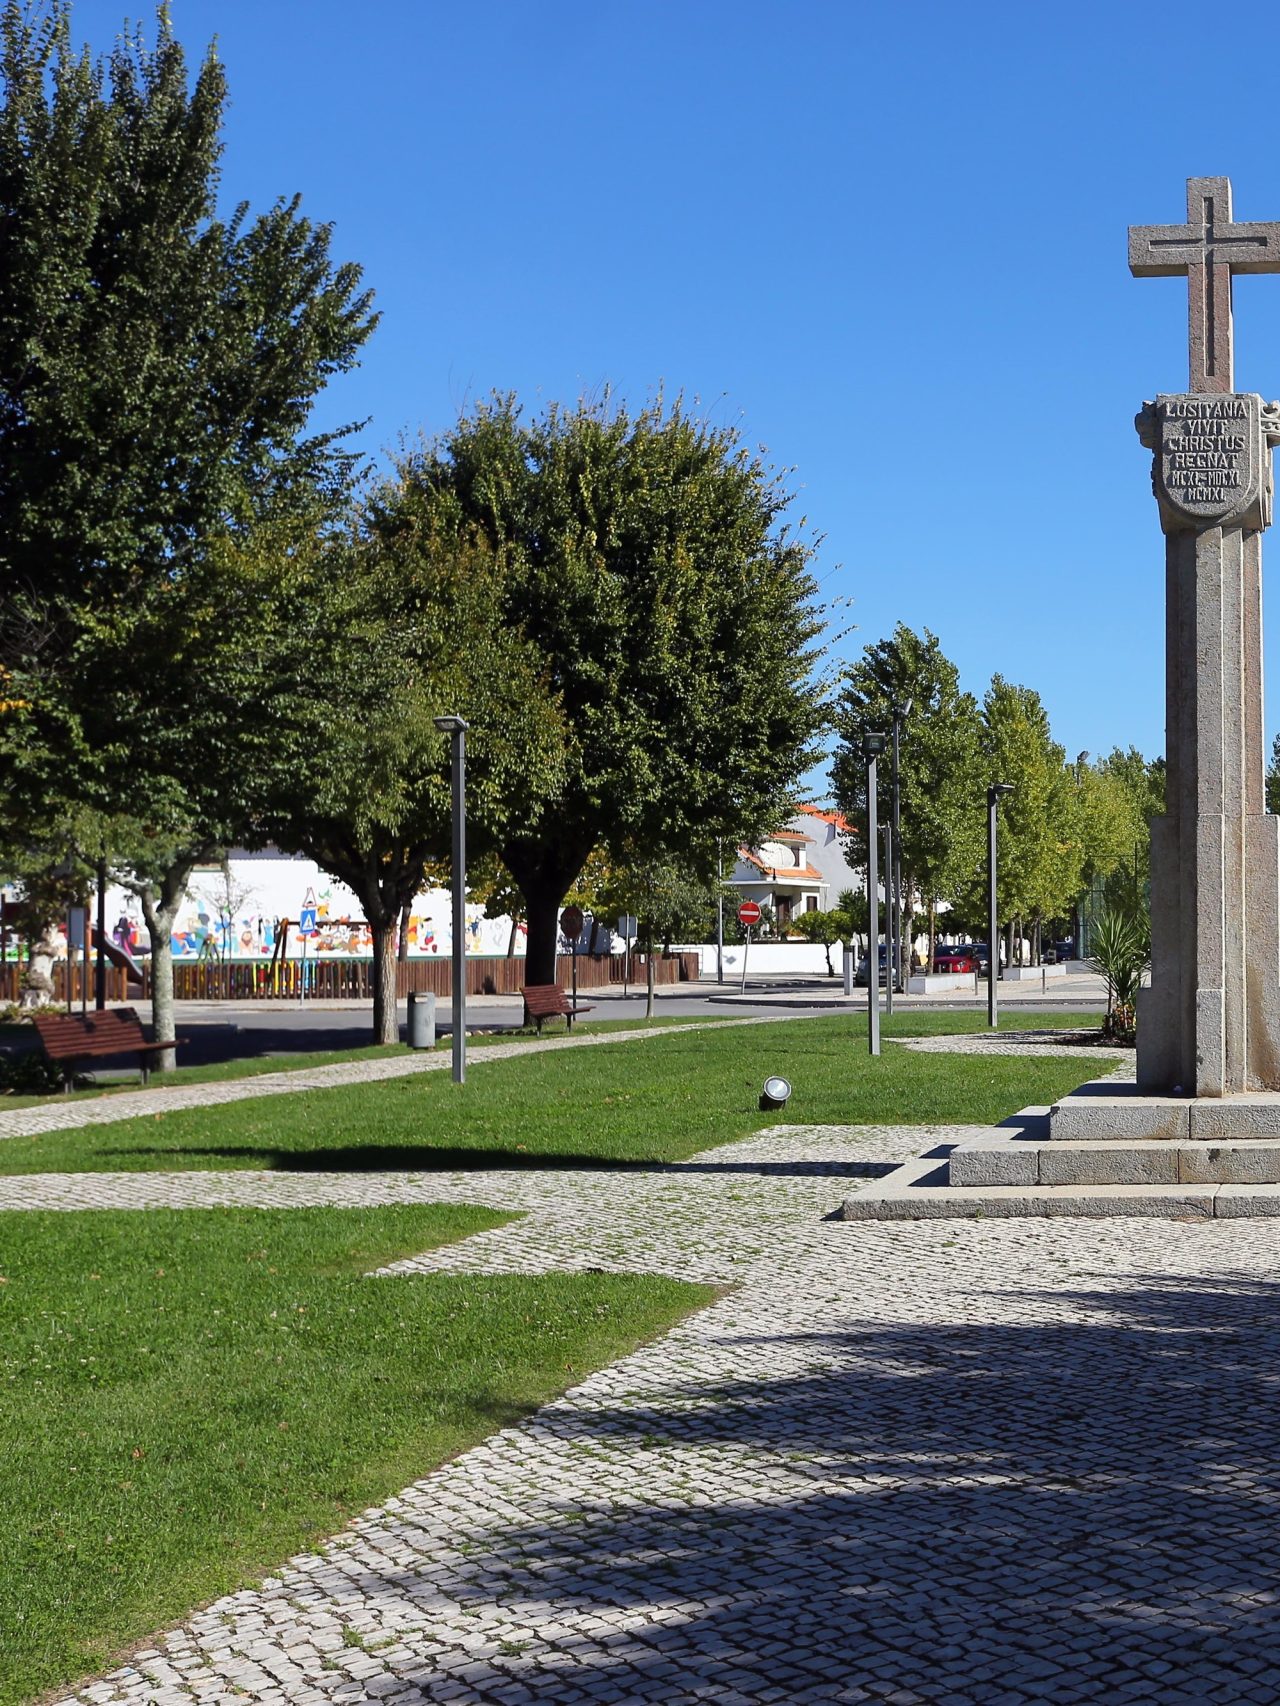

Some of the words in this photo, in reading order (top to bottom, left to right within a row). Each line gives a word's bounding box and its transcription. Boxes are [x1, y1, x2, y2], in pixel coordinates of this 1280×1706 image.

[1166, 401, 1248, 418] LUSITANIA
[1187, 419, 1228, 435] VIVIT
[1169, 435, 1246, 451] CHRISTUS
[1174, 452, 1239, 468] REGNAT
[1188, 487, 1227, 501] MCMXL
